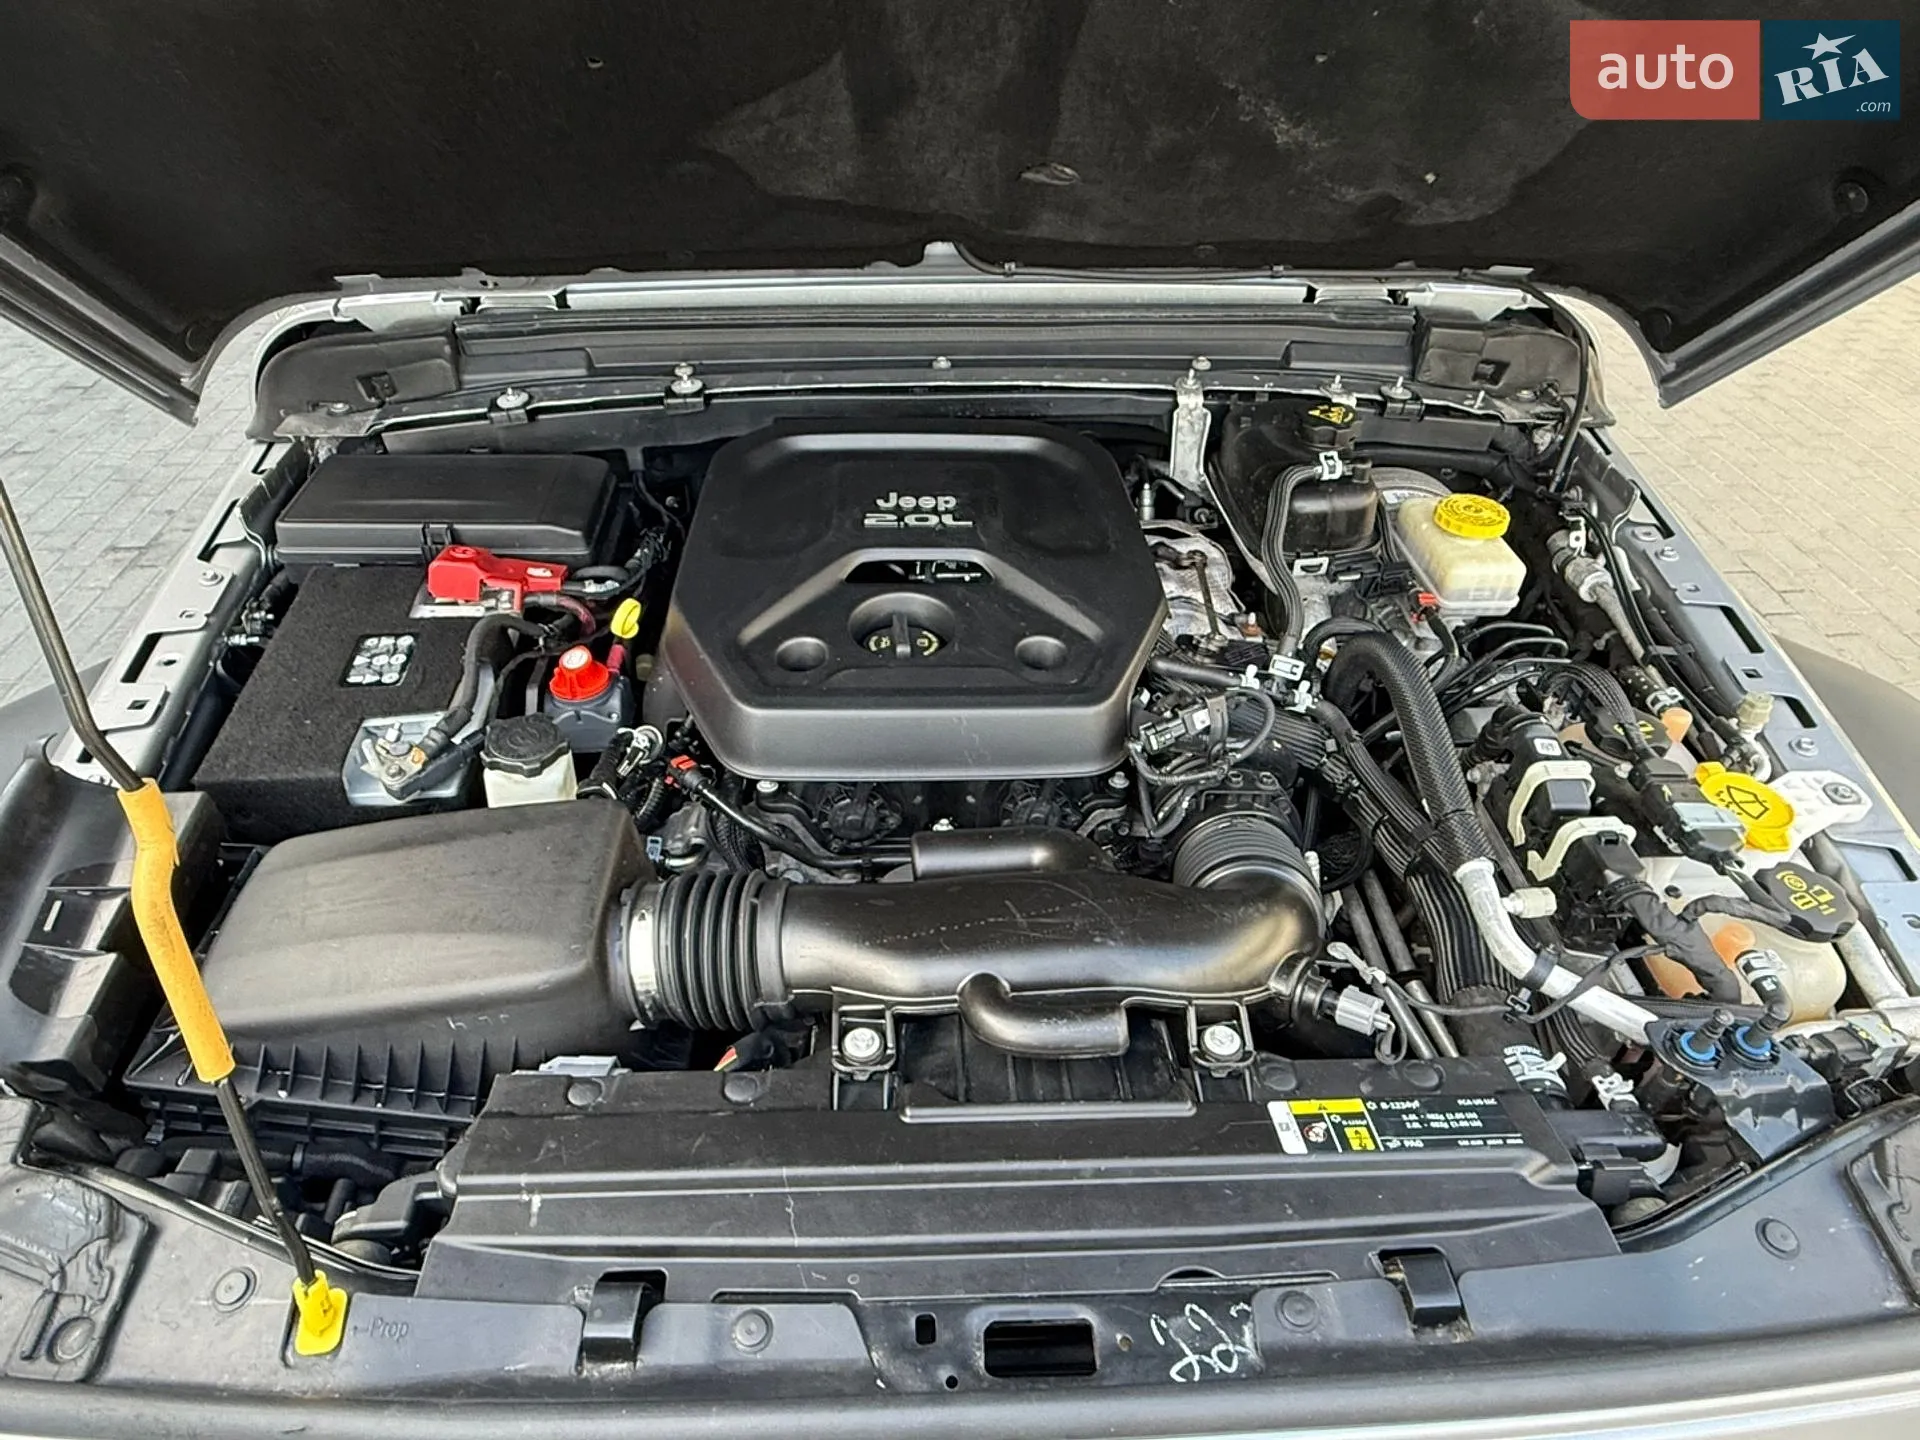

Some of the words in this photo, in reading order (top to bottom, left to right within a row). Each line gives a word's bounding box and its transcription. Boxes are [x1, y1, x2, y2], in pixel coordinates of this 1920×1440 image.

[875, 492, 957, 511] Jeep
[863, 513, 974, 529] 2.0L
[370, 1316, 409, 1342] Prop
